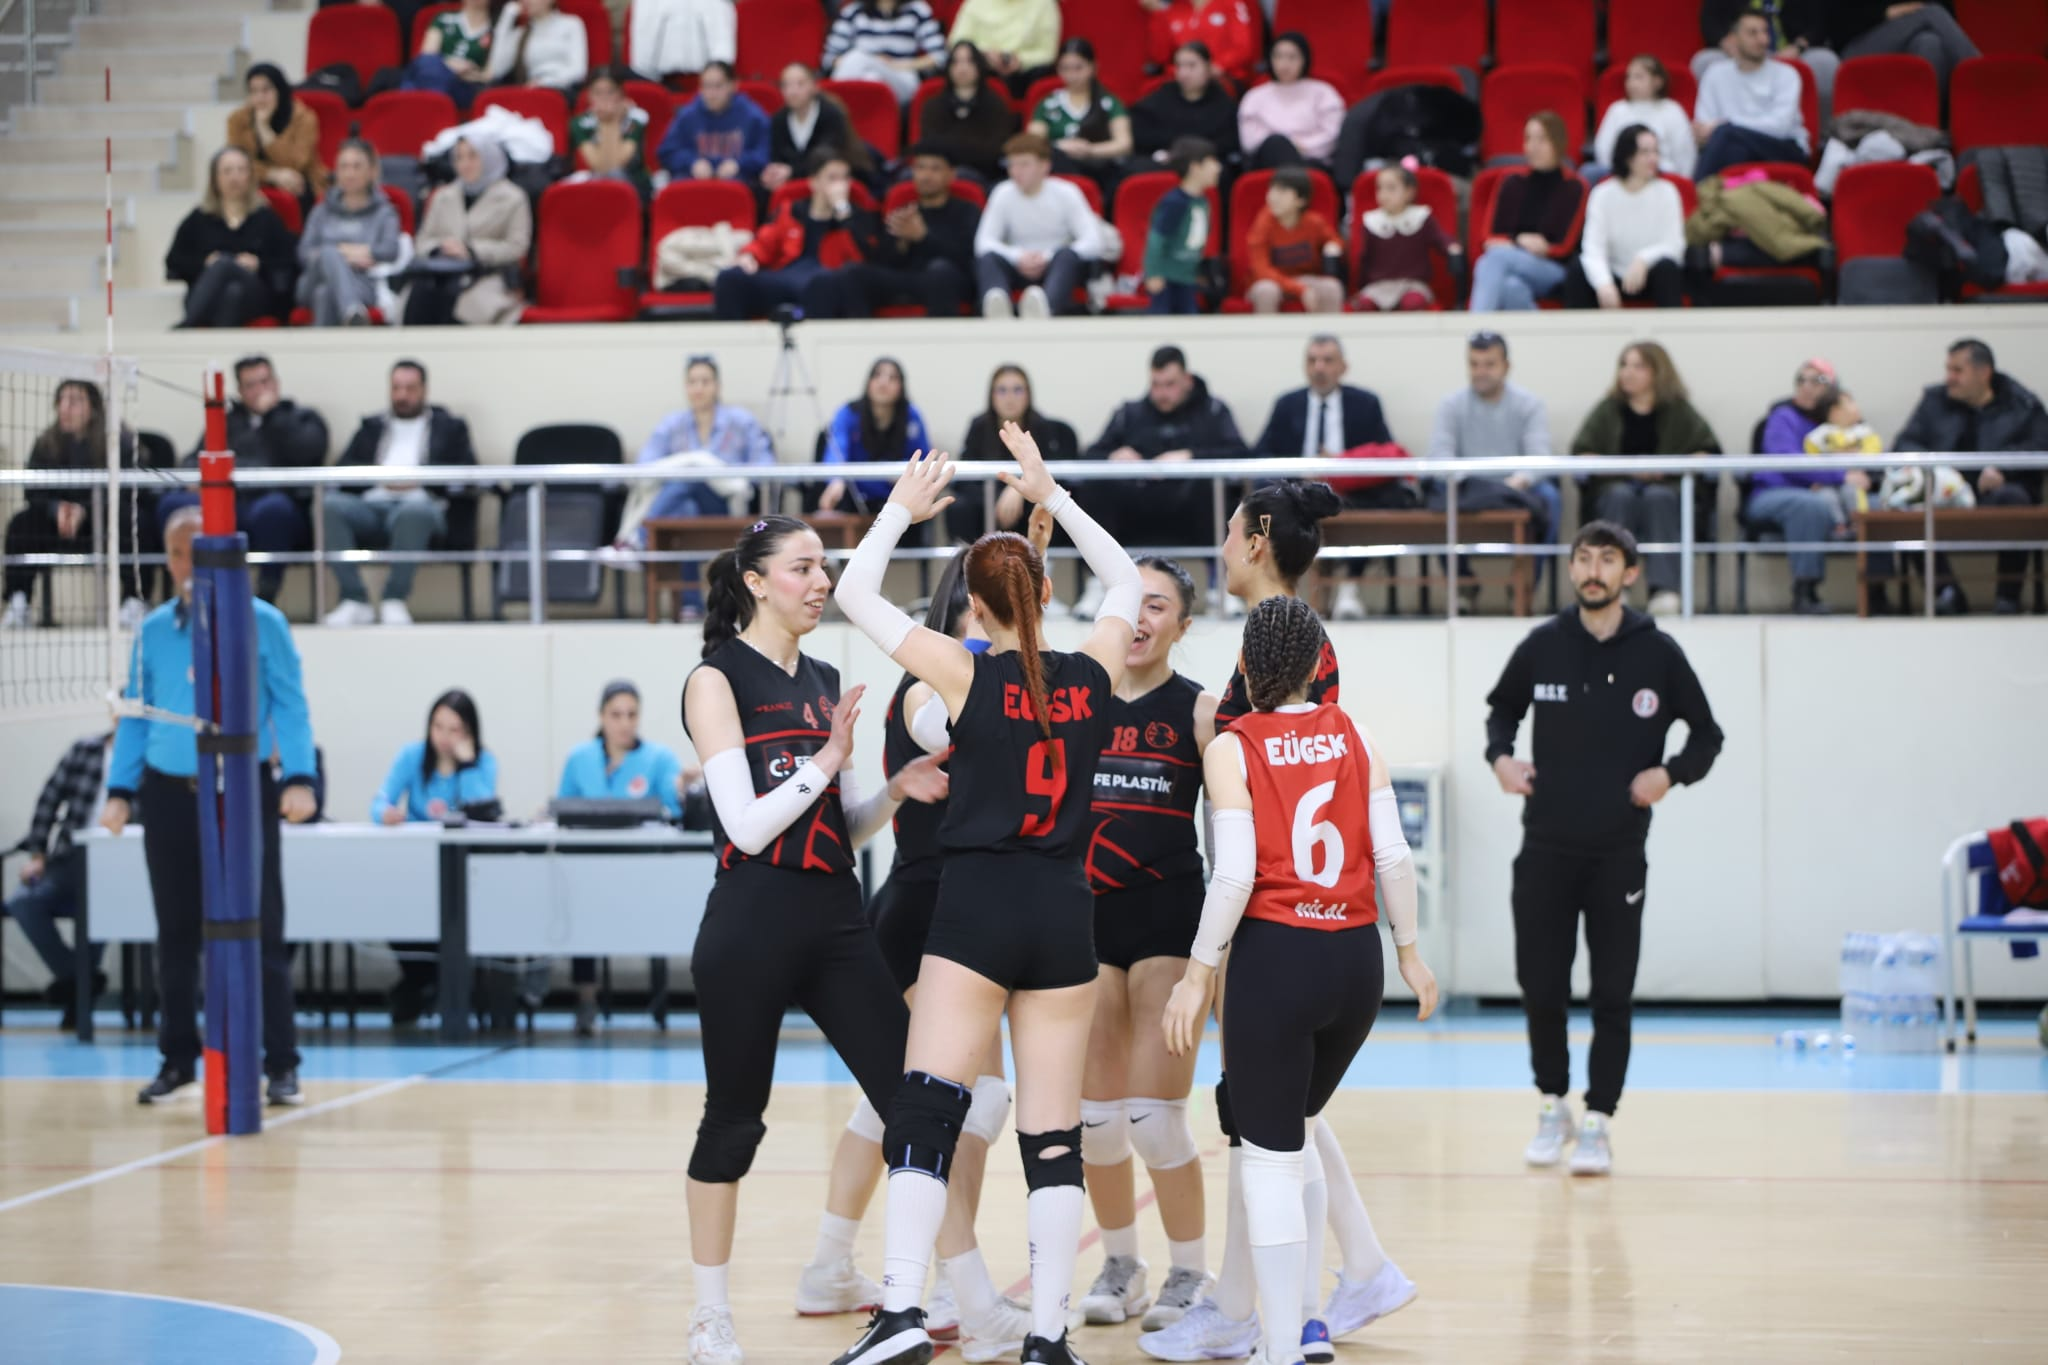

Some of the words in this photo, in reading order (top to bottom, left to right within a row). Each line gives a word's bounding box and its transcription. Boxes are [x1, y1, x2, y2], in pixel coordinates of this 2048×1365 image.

[803, 702, 819, 729] 4
[1111, 725, 1139, 752] 18
[1264, 730, 1348, 766] EÜGSK
[1020, 737, 1068, 837] 9
[1112, 774, 1173, 794] PLASTİK
[1291, 780, 1345, 888] 6
